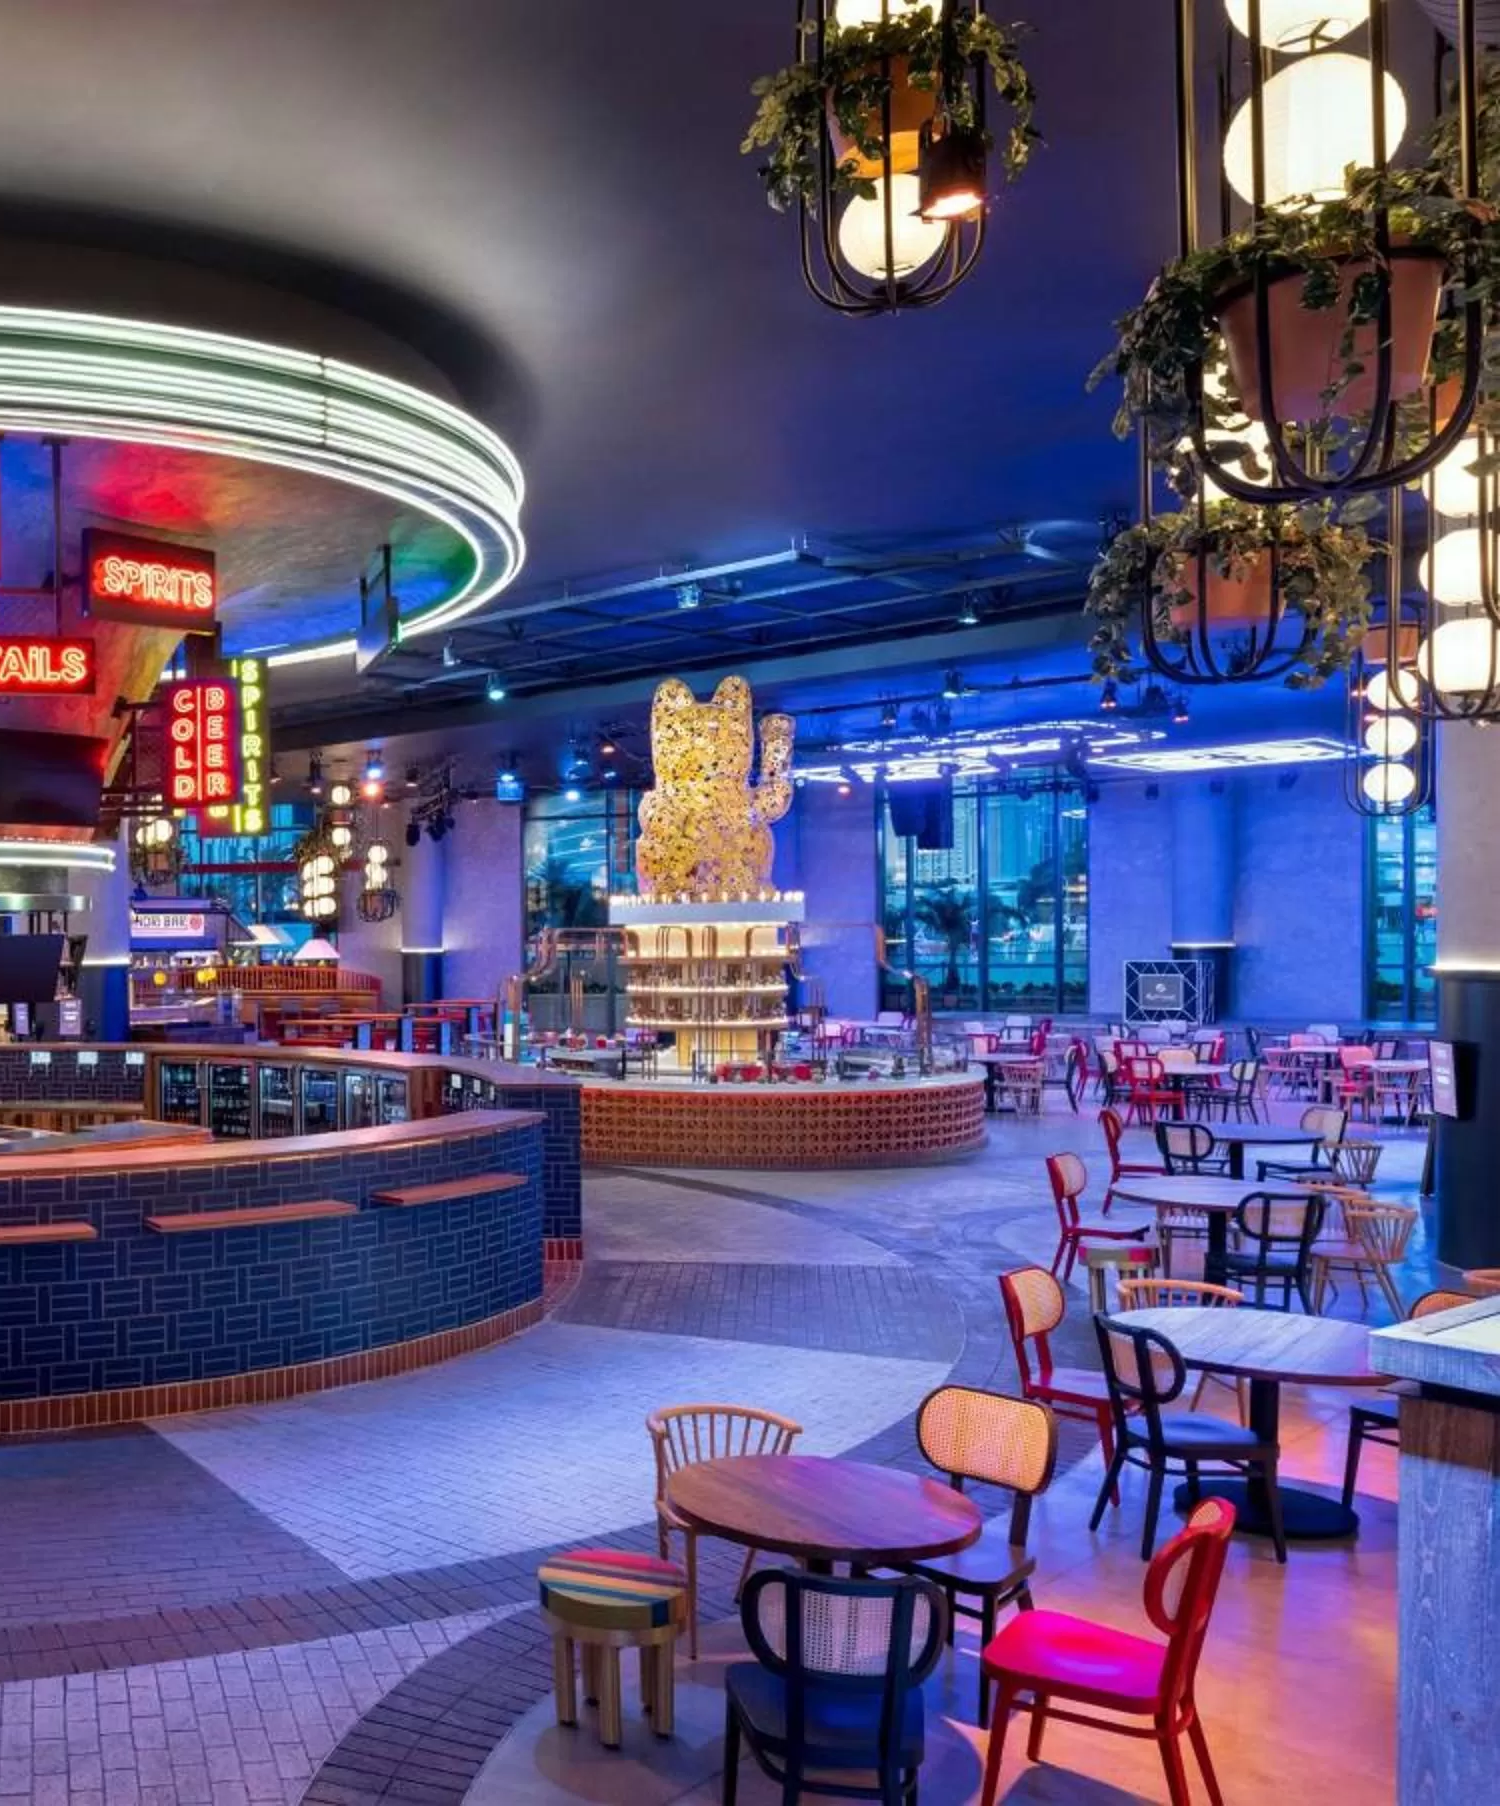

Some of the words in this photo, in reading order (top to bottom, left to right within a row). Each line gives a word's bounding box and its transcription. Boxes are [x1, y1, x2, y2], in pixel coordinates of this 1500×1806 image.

[103, 555, 213, 608] SPIRITS
[171, 689, 195, 799] COLD
[205, 687, 227, 796] BEER
[241, 659, 263, 833] SPIRITS
